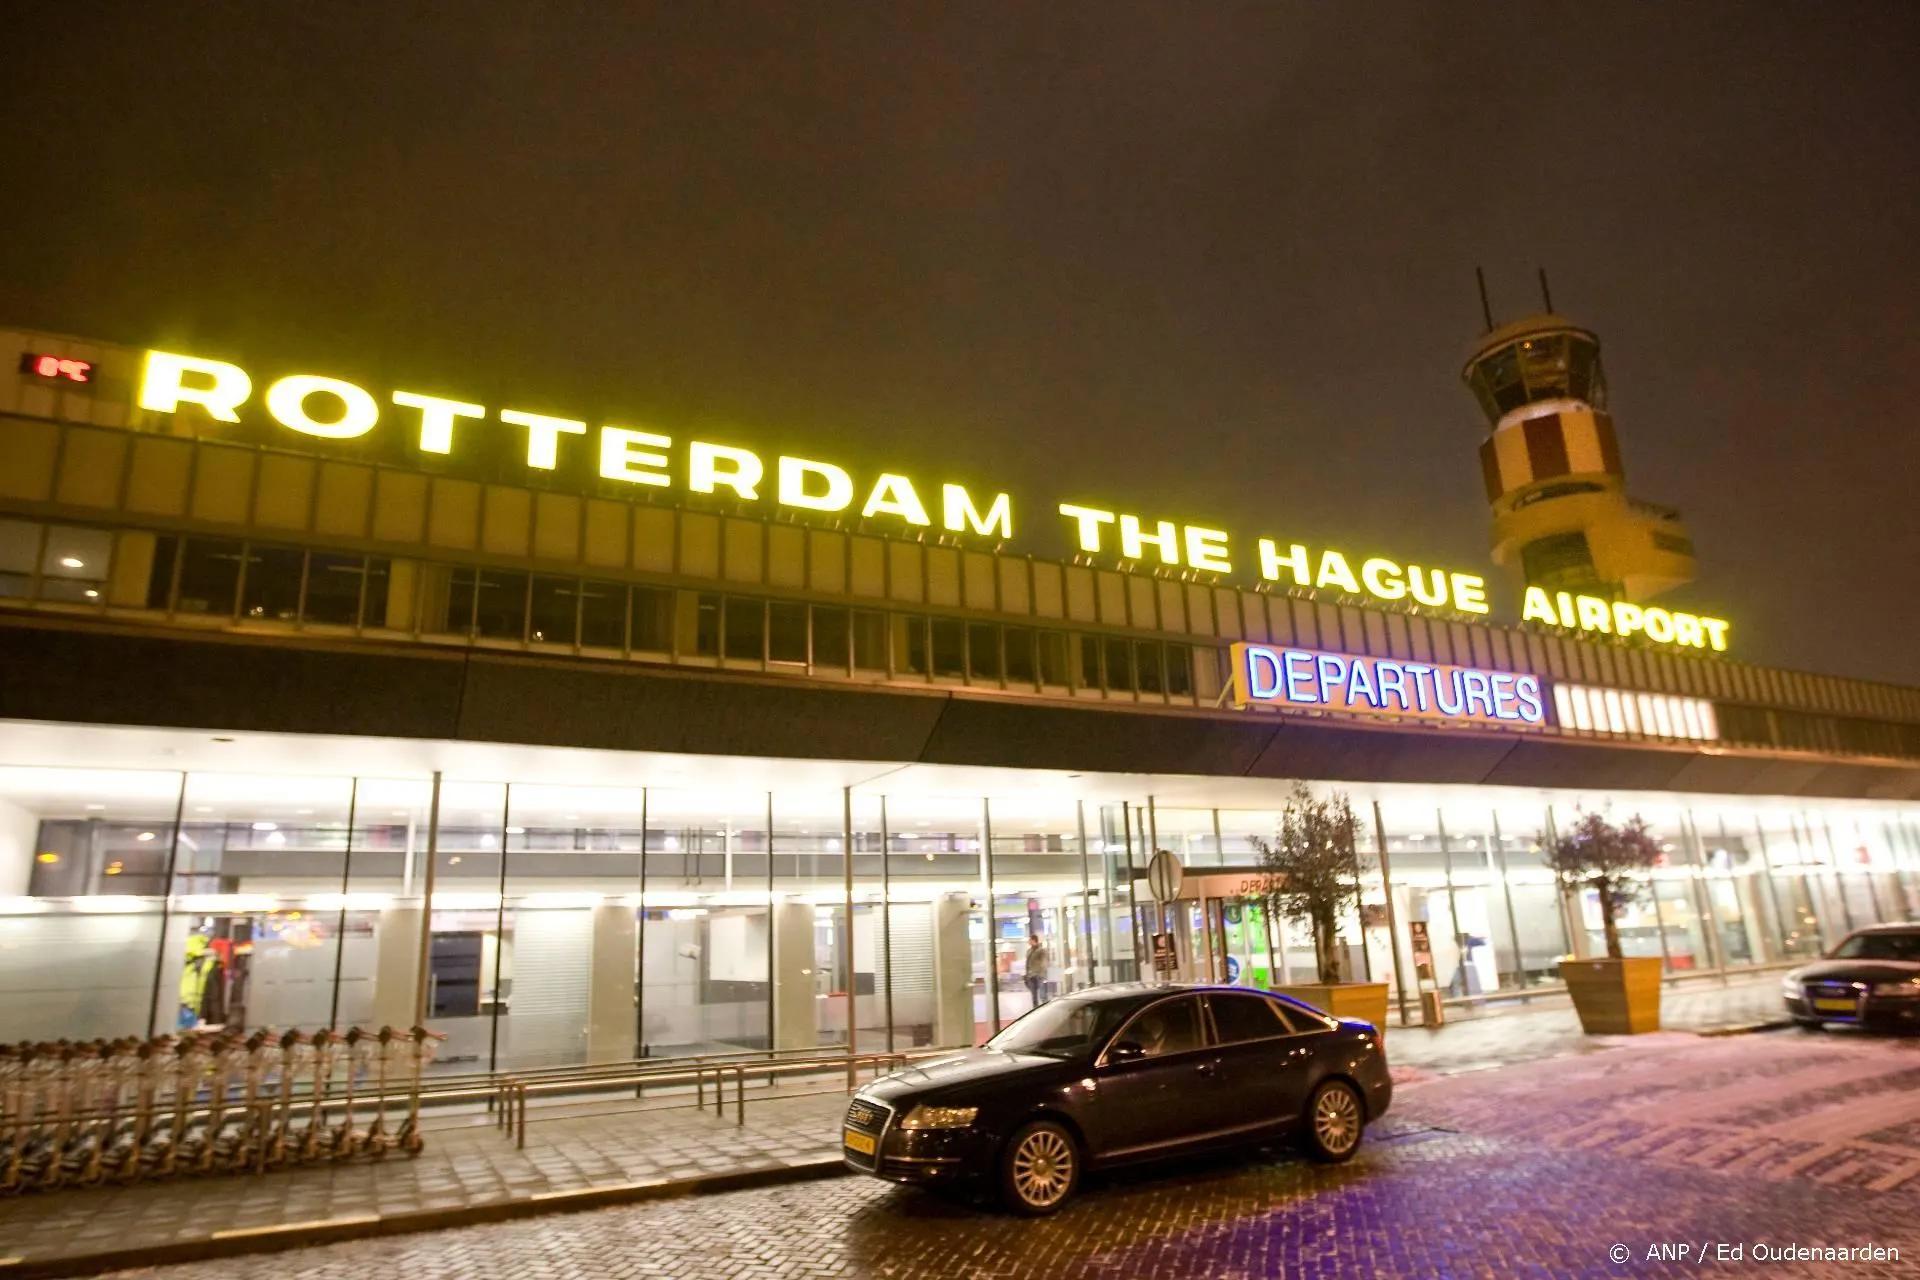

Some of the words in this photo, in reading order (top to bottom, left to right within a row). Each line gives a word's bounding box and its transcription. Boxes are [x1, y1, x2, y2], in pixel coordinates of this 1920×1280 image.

[137, 350, 1012, 539] ROTTERDAM
[1059, 503, 1231, 574] THE
[1259, 538, 1489, 614] HAGUE
[1522, 586, 1730, 652] AIRPORT
[1247, 646, 1545, 723] DEPARTURES
